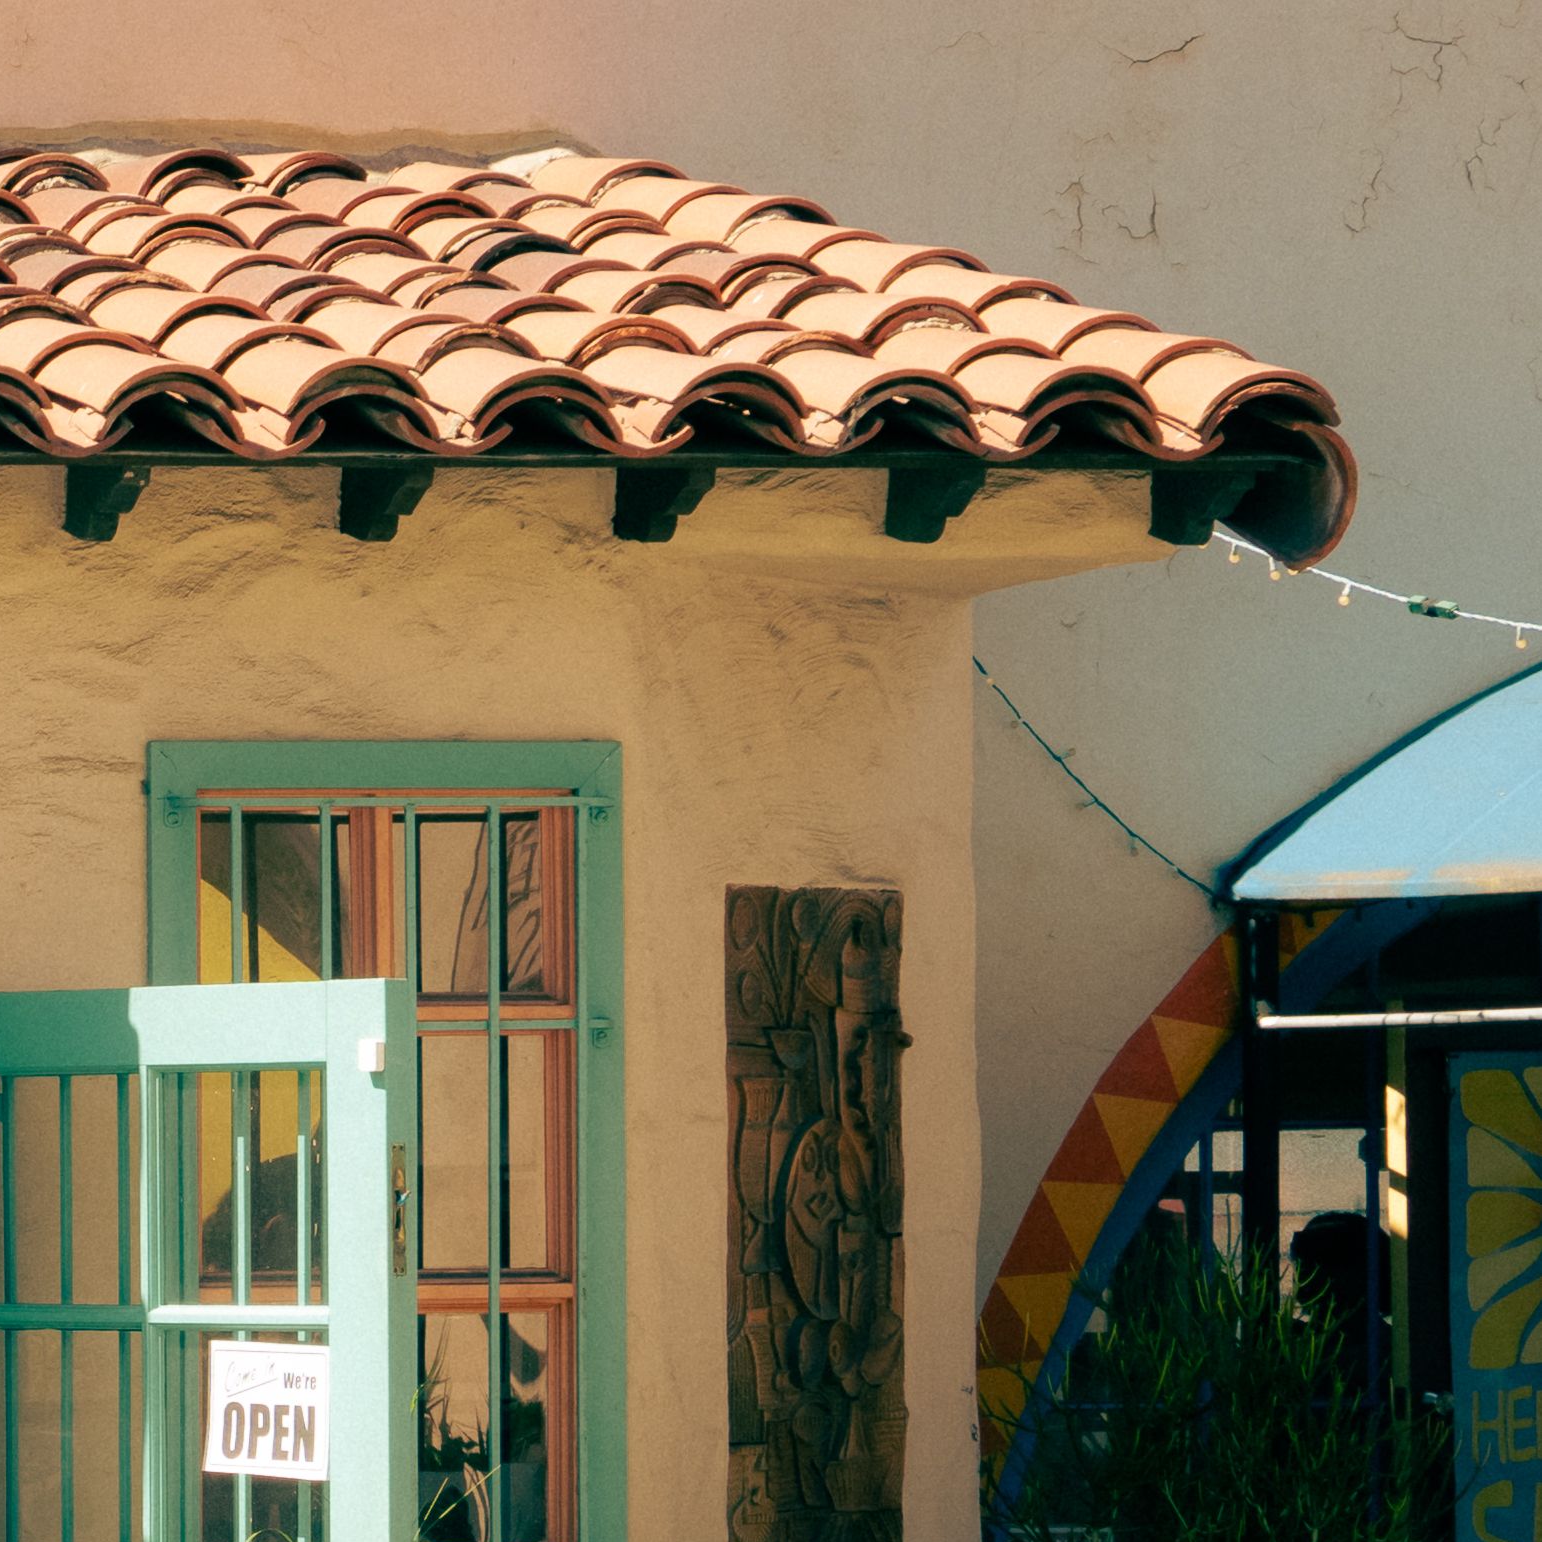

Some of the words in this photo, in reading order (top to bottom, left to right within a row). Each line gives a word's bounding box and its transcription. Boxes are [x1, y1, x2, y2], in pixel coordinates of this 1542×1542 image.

[282, 1371, 318, 1391] We're
[221, 1401, 316, 1463] OPEN
[1471, 1384, 1542, 1465] HE
